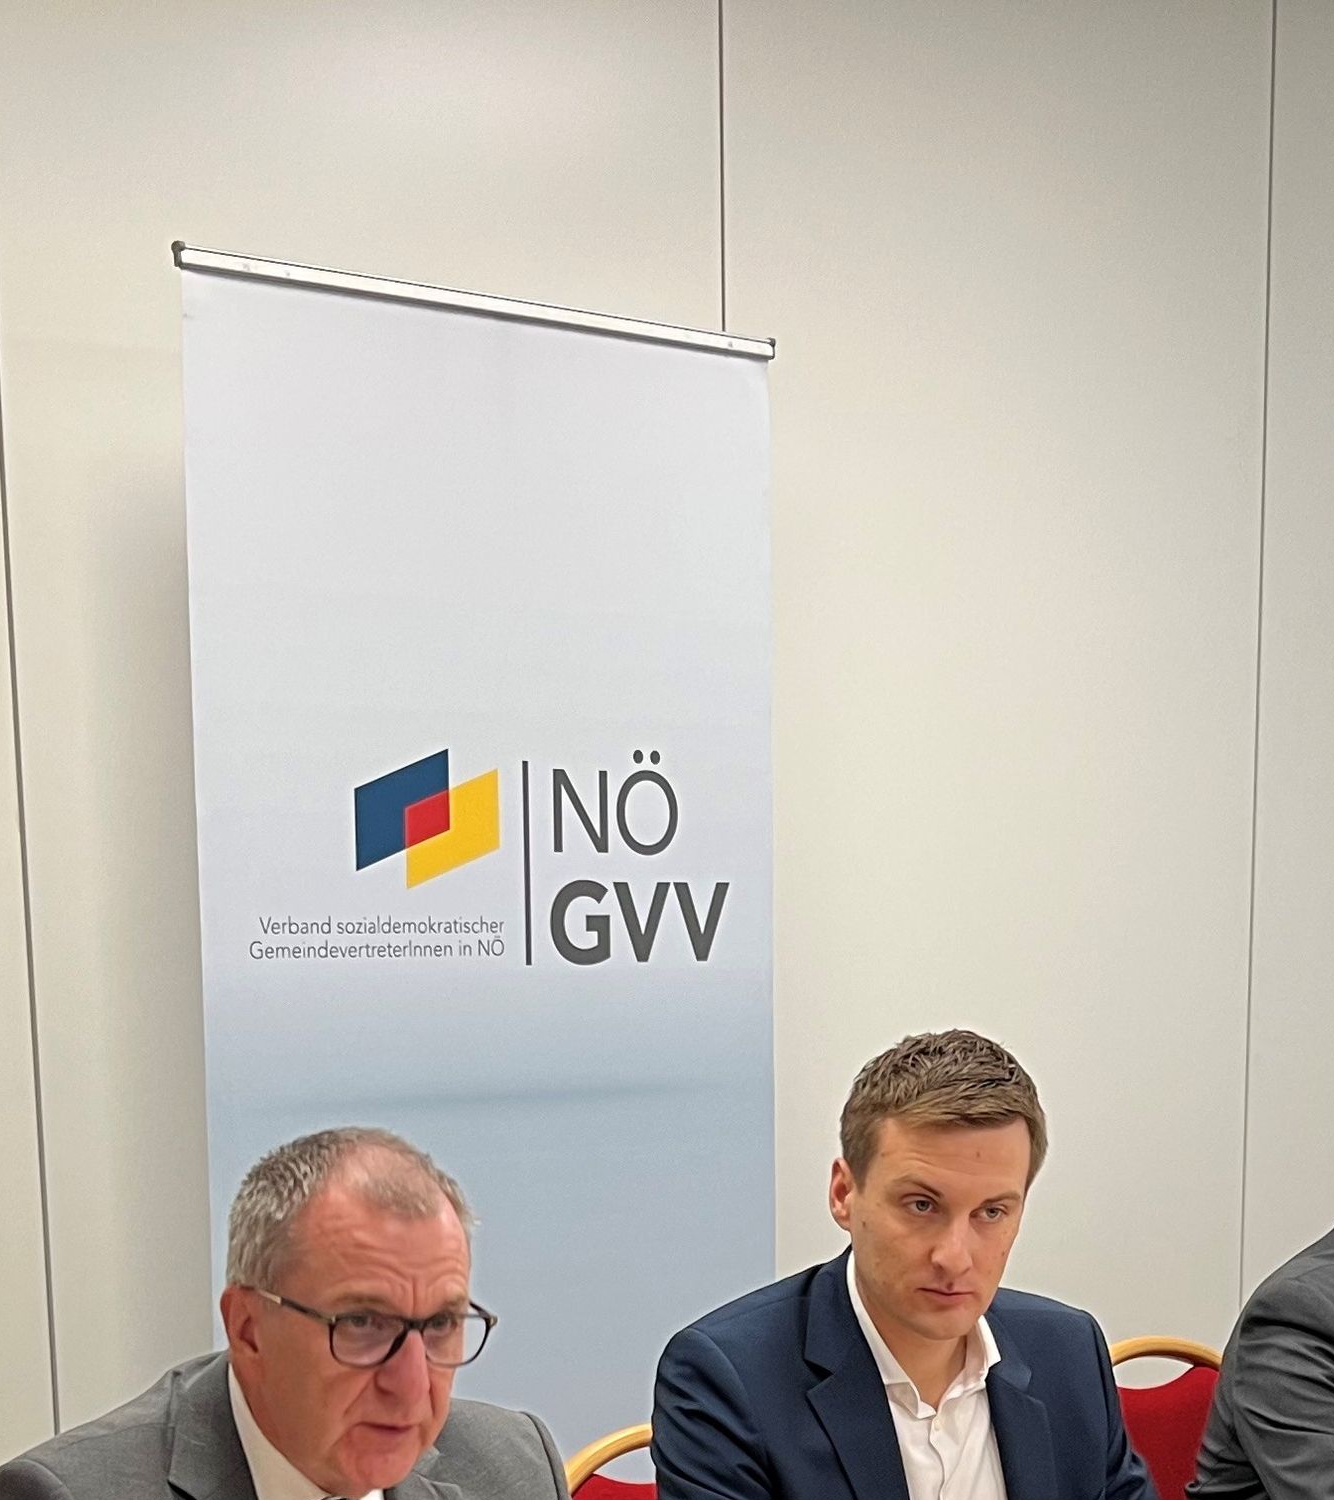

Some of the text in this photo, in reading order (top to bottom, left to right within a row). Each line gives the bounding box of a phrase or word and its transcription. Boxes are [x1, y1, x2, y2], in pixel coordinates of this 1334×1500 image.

[553, 749, 679, 856] NÖ
[249, 936, 505, 960] GemeindevertreterInnen in NÖ
[259, 916, 505, 935] Verband sozialdemokratischer
[550, 879, 730, 966] GVV
